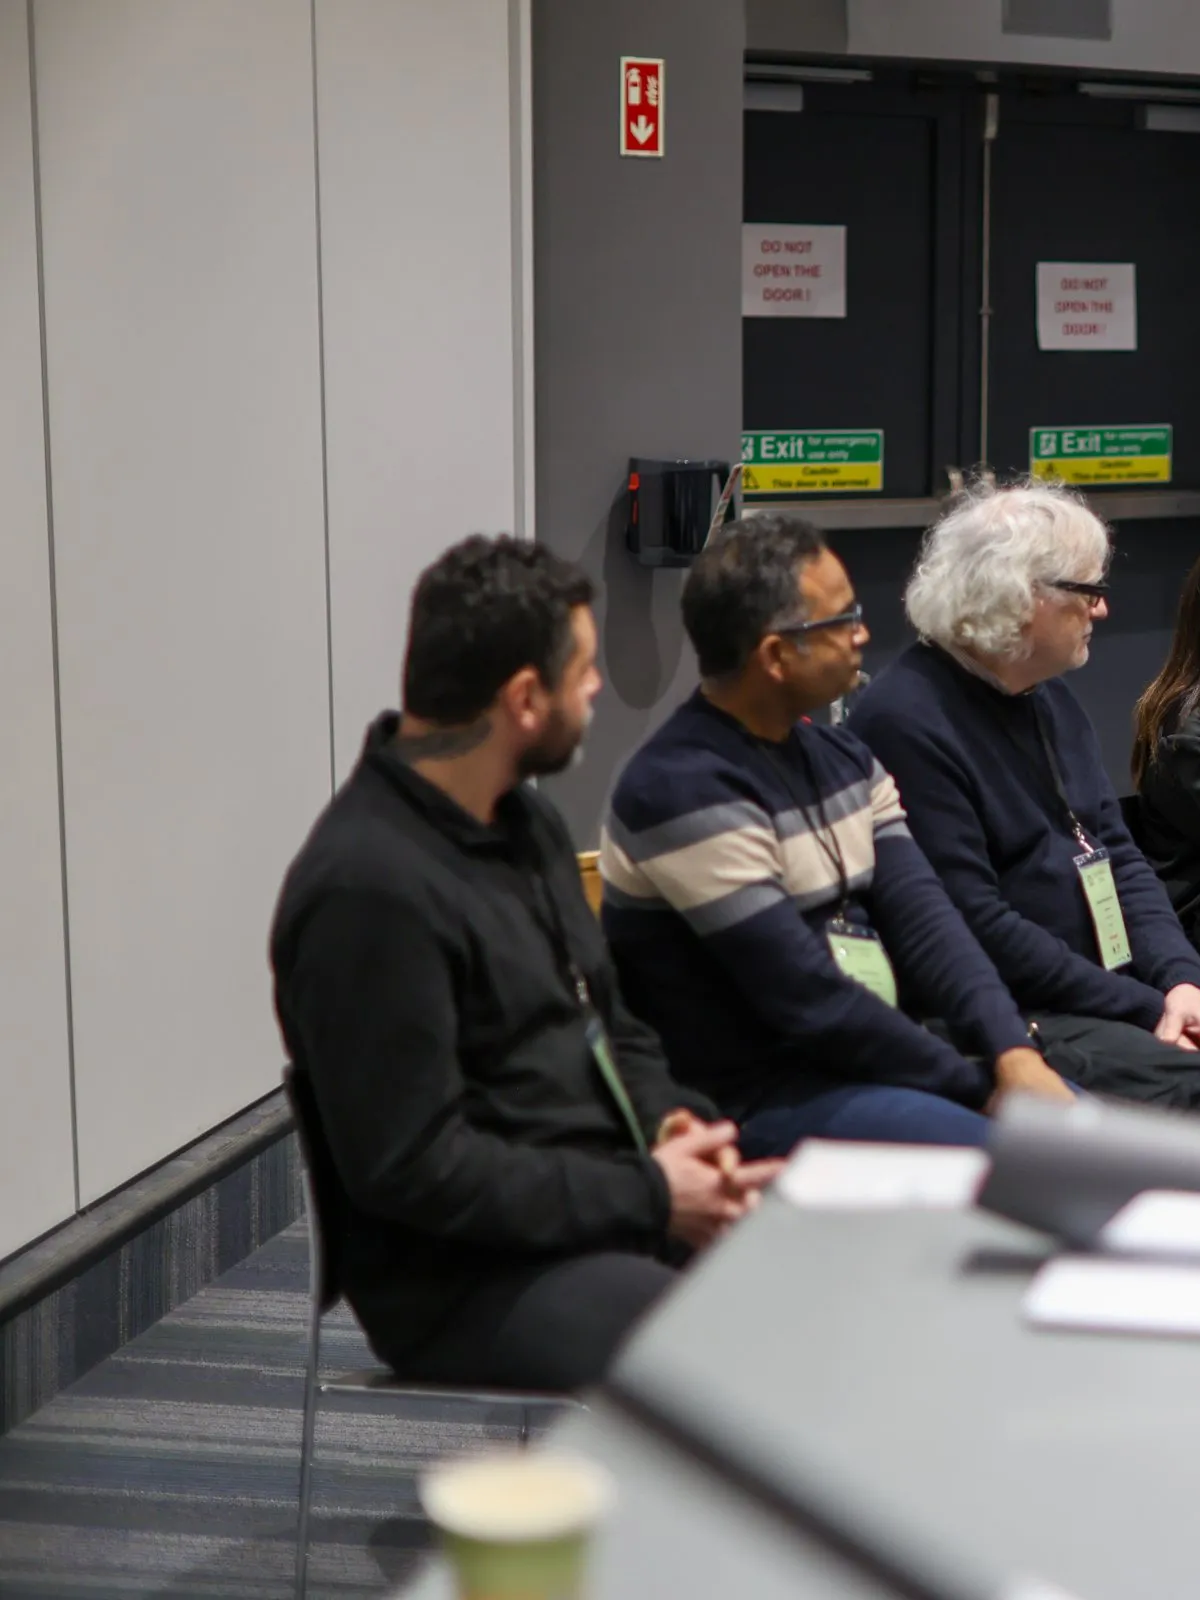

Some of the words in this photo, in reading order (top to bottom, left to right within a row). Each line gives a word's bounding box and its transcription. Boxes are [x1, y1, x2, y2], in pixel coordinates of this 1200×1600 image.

[761, 240, 782, 254] DO
[784, 241, 813, 254] NOT
[753, 264, 791, 277] OPEN
[794, 265, 821, 278] THE
[1060, 277, 1078, 291] DO
[1081, 278, 1108, 291] NOT
[763, 288, 803, 302] DOOR
[1055, 301, 1088, 314] OPEN
[1091, 302, 1113, 314] THE
[760, 436, 805, 459] Exit
[824, 437, 877, 447] emergency
[1061, 432, 1101, 453] Exit
[807, 451, 825, 460] use
[827, 450, 849, 460] only
[801, 466, 841, 476] Caution
